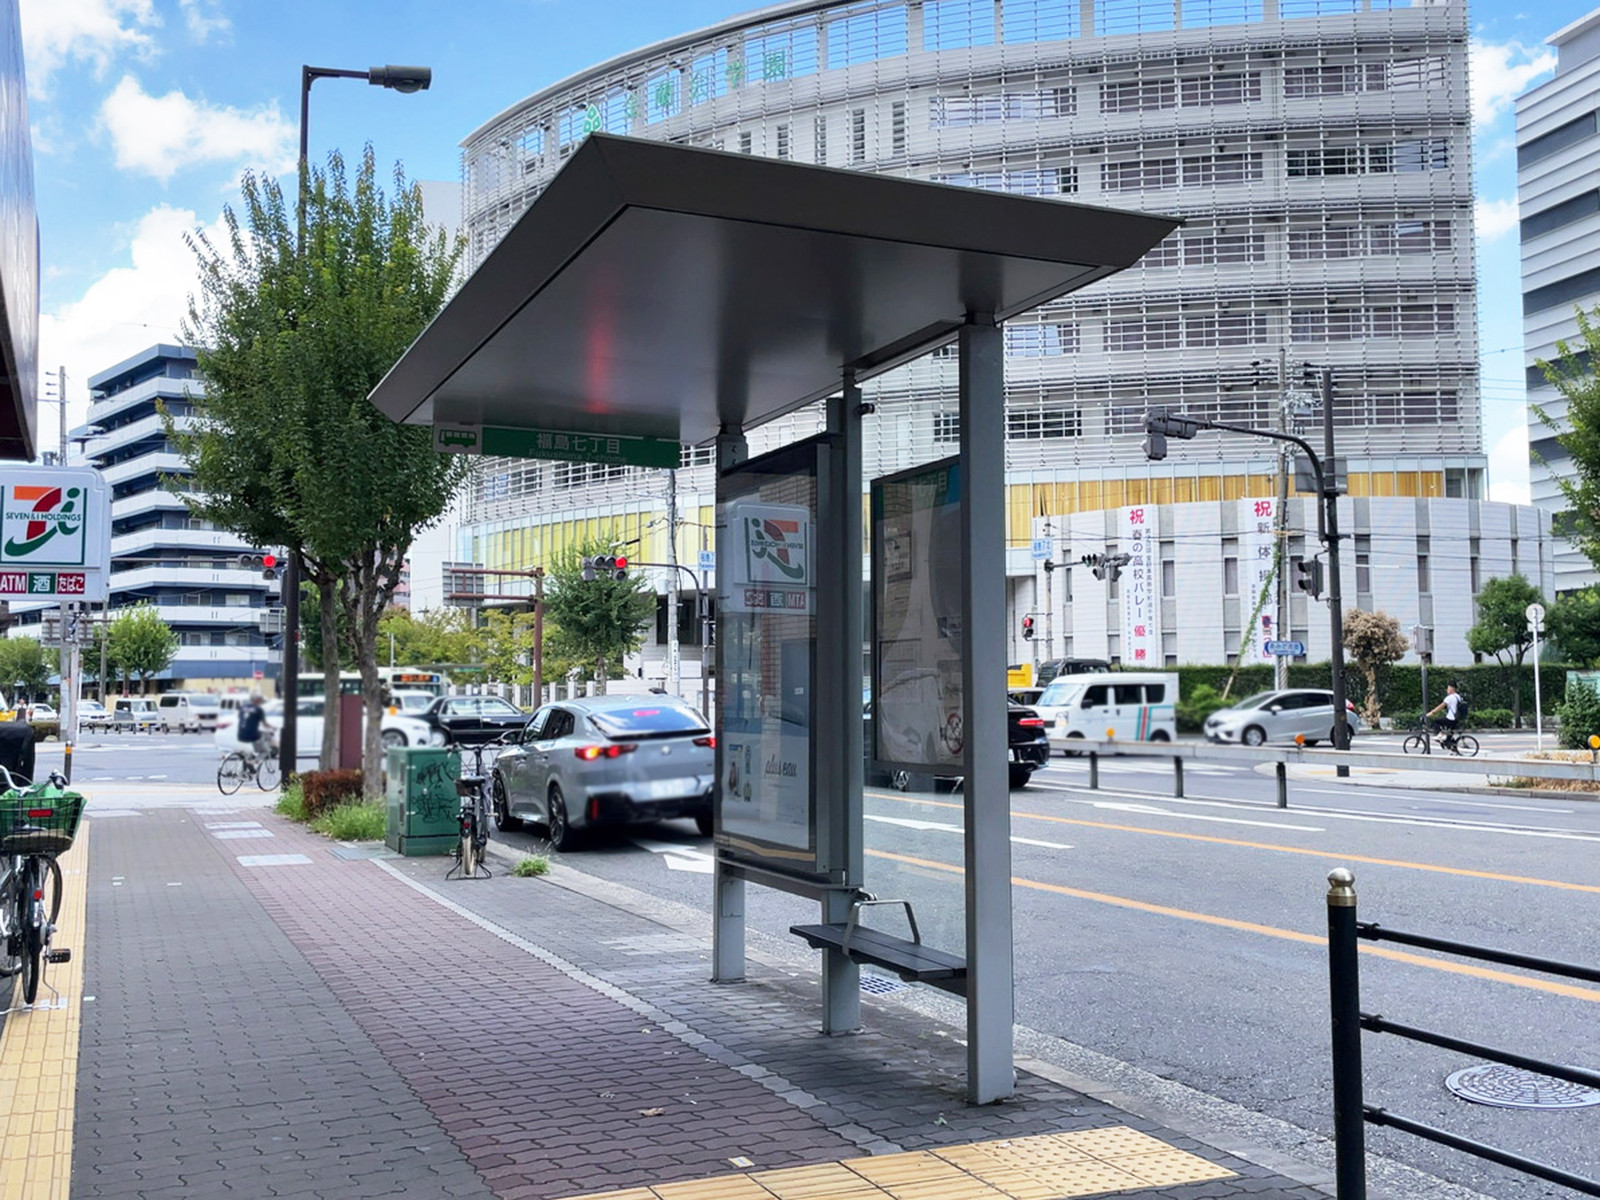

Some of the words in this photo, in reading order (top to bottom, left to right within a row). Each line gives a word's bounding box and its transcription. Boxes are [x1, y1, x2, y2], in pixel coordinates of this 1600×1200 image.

[537, 432, 621, 454] 福島七丁目
[529, 448, 582, 460] Fukushima
[586, 451, 627, 464] 7-chome
[5, 512, 30, 520] SEVEN
[41, 514, 82, 522] HOLDINGS
[1129, 508, 1145, 525] 祝
[1253, 501, 1272, 518] 祝
[0, 575, 26, 591] ATM
[33, 575, 51, 592] 酒
[58, 576, 85, 592] たばこ
